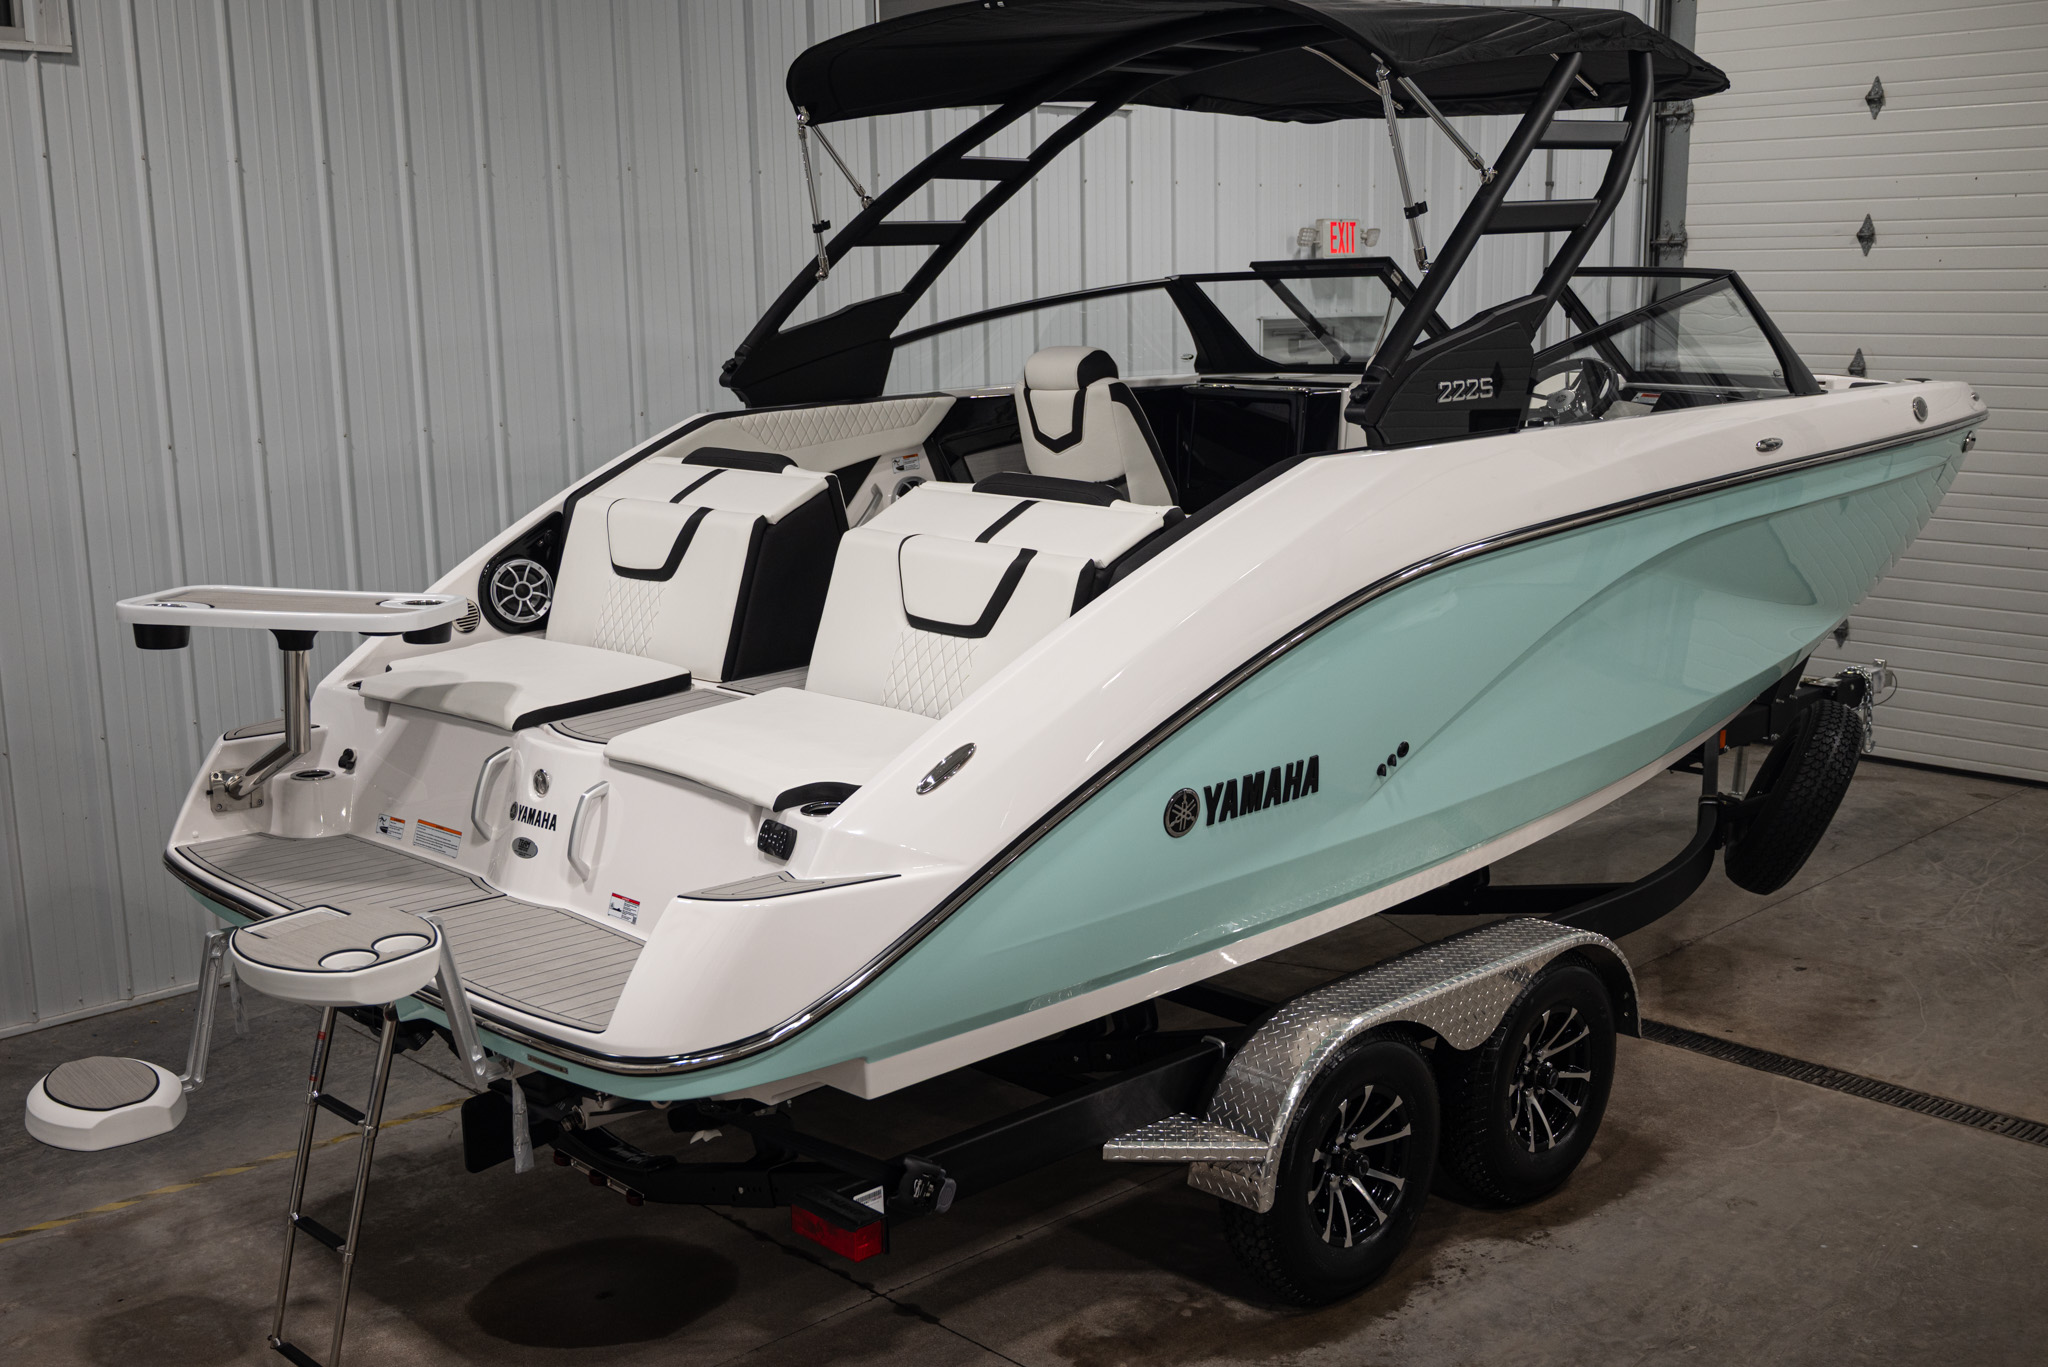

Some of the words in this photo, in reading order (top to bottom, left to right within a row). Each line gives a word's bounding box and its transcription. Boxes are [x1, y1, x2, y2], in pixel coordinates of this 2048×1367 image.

[1330, 221, 1356, 254] EXIT
[1437, 377, 1494, 403] 2225
[1203, 754, 1320, 827] YAMAHA
[517, 804, 557, 832] YAMAHA
